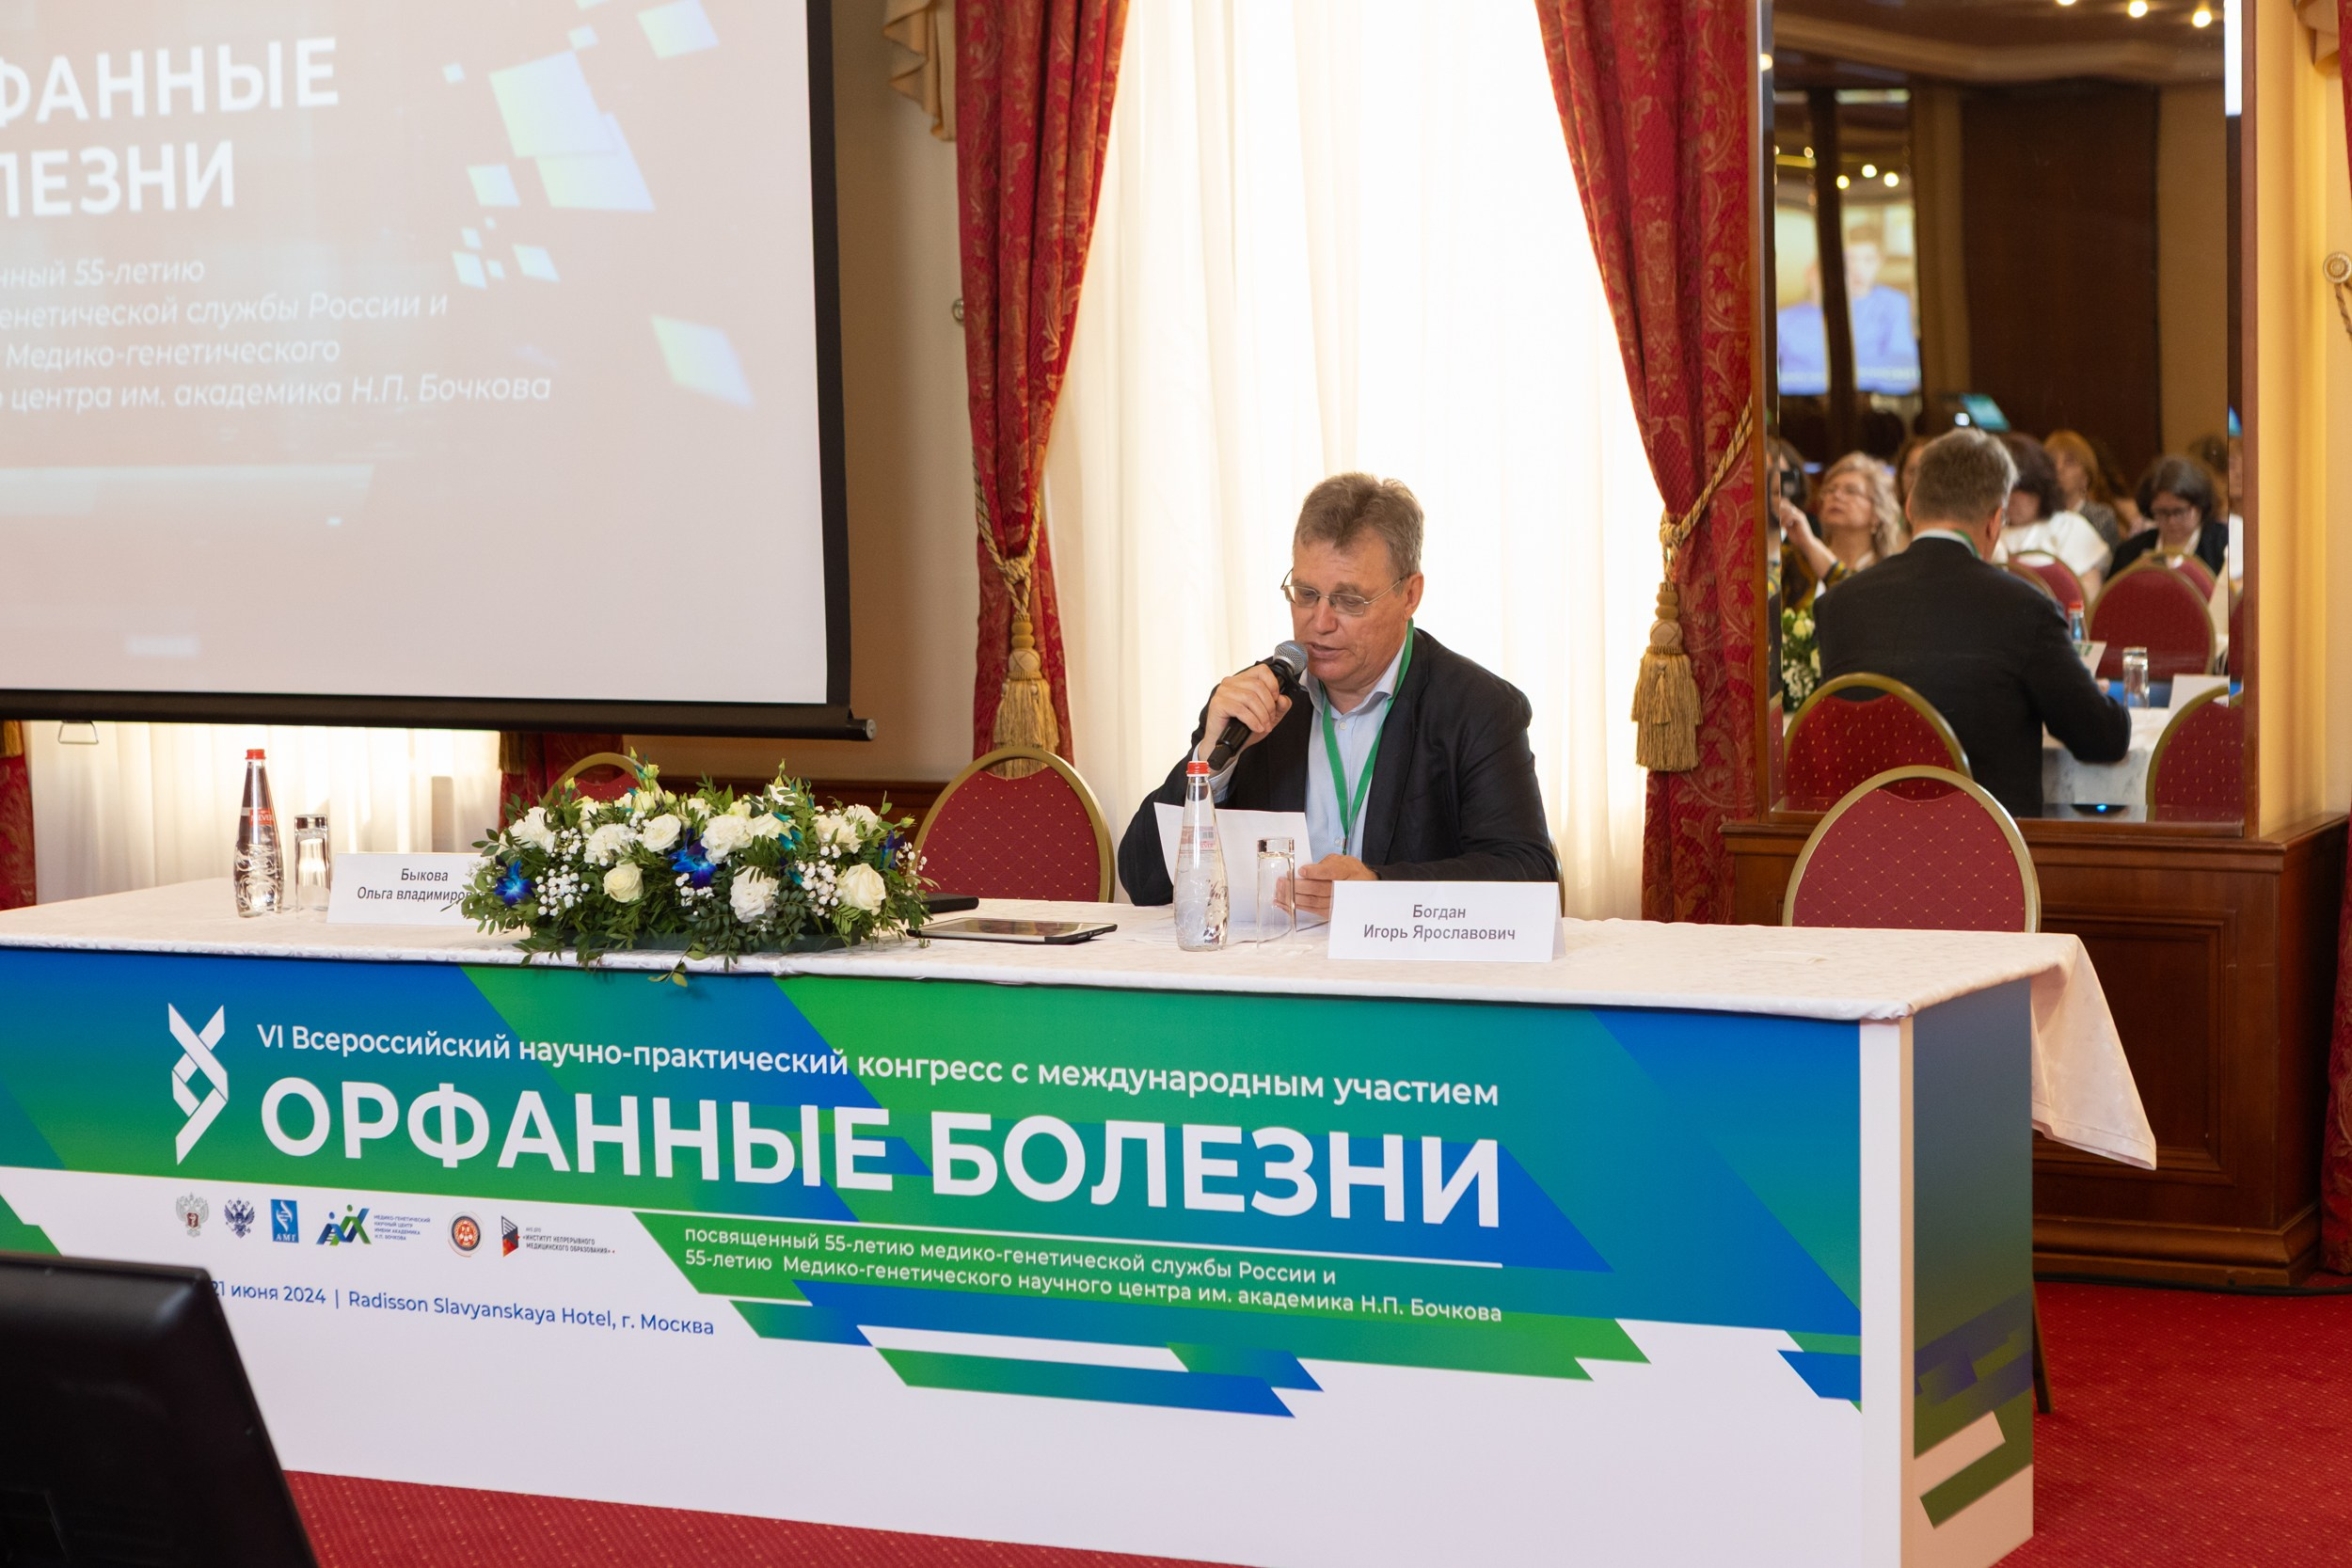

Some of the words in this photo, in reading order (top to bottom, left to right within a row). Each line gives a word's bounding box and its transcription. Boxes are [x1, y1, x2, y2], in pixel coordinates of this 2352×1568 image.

[74, 257, 205, 286] 55-летию
[186, 293, 299, 331] службы
[309, 290, 421, 320] России
[429, 294, 449, 316] и
[6, 336, 341, 371] Медико-генетического
[12, 386, 112, 416] центра
[120, 386, 167, 407] им.
[174, 379, 342, 408] академика
[351, 377, 410, 404] Н.П.
[419, 373, 551, 404] Бочкова
[401, 867, 449, 882] Быкова
[357, 886, 393, 900] Ольга
[1412, 904, 1467, 921] Богдан
[1363, 924, 1408, 942] Игорь
[1413, 925, 1516, 942] Ярославович
[256, 1023, 284, 1049] VI
[292, 1024, 510, 1060] Всероссийский
[519, 1039, 849, 1076] научно-практический
[858, 1057, 1003, 1087] конгресс
[1011, 1063, 1029, 1084] с
[1038, 1064, 1324, 1099] международным
[1333, 1076, 1499, 1107] участием
[261, 1075, 894, 1191] ОРФАННЫЕ
[931, 1110, 1501, 1228] БОЛЕЗНИ
[526, 1243, 569, 1252] МЕДИЦИНСКОГО
[552, 1236, 596, 1245] НЕПРЕРЫВНОГО
[685, 1227, 819, 1251] посвященный
[824, 1233, 915, 1257] 55-летию
[920, 1243, 1146, 1272] медико-генетической
[1151, 1256, 1232, 1280] службы
[1239, 1260, 1316, 1283] России
[1323, 1270, 1337, 1285] и
[685, 1249, 772, 1274] 55-летию
[783, 1255, 1012, 1288] Медико-генетического
[1018, 1274, 1113, 1295] научного
[1119, 1281, 1192, 1305] центра
[1198, 1288, 1232, 1304] им.
[1238, 1289, 1354, 1312] академика
[1361, 1295, 1405, 1315] Н.П.
[1410, 1299, 1502, 1323] Бочкова
[231, 1285, 278, 1301] июня
[283, 1286, 326, 1304] 2024
[349, 1291, 428, 1313] Radisson
[434, 1297, 555, 1325] Slavyanskaya
[562, 1307, 616, 1329] Hotel,
[622, 1316, 636, 1329] г.
[641, 1315, 715, 1336] Москва
